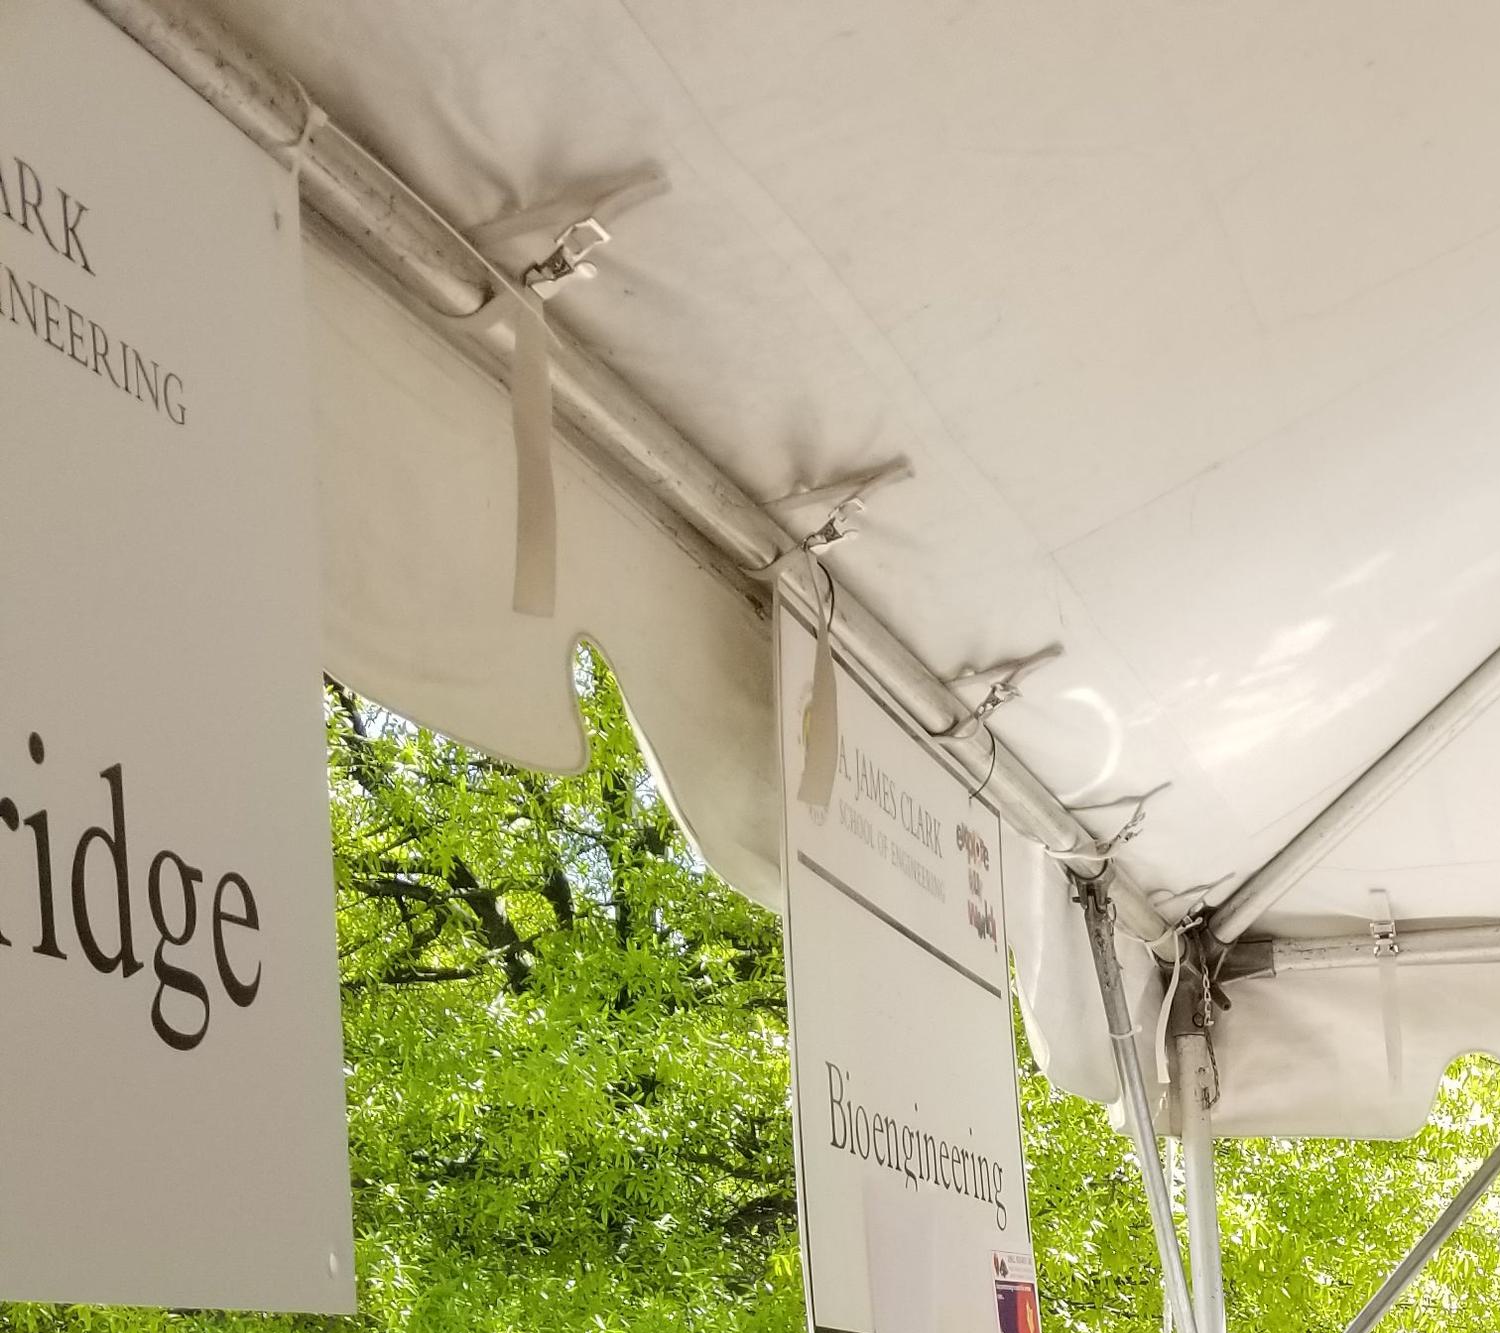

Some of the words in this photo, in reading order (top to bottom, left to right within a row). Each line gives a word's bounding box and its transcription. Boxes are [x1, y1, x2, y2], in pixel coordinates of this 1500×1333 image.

[855, 748, 897, 820] JAMES
[900, 791, 943, 859] CLARK
[825, 1060, 1009, 1232] Bioengineering
